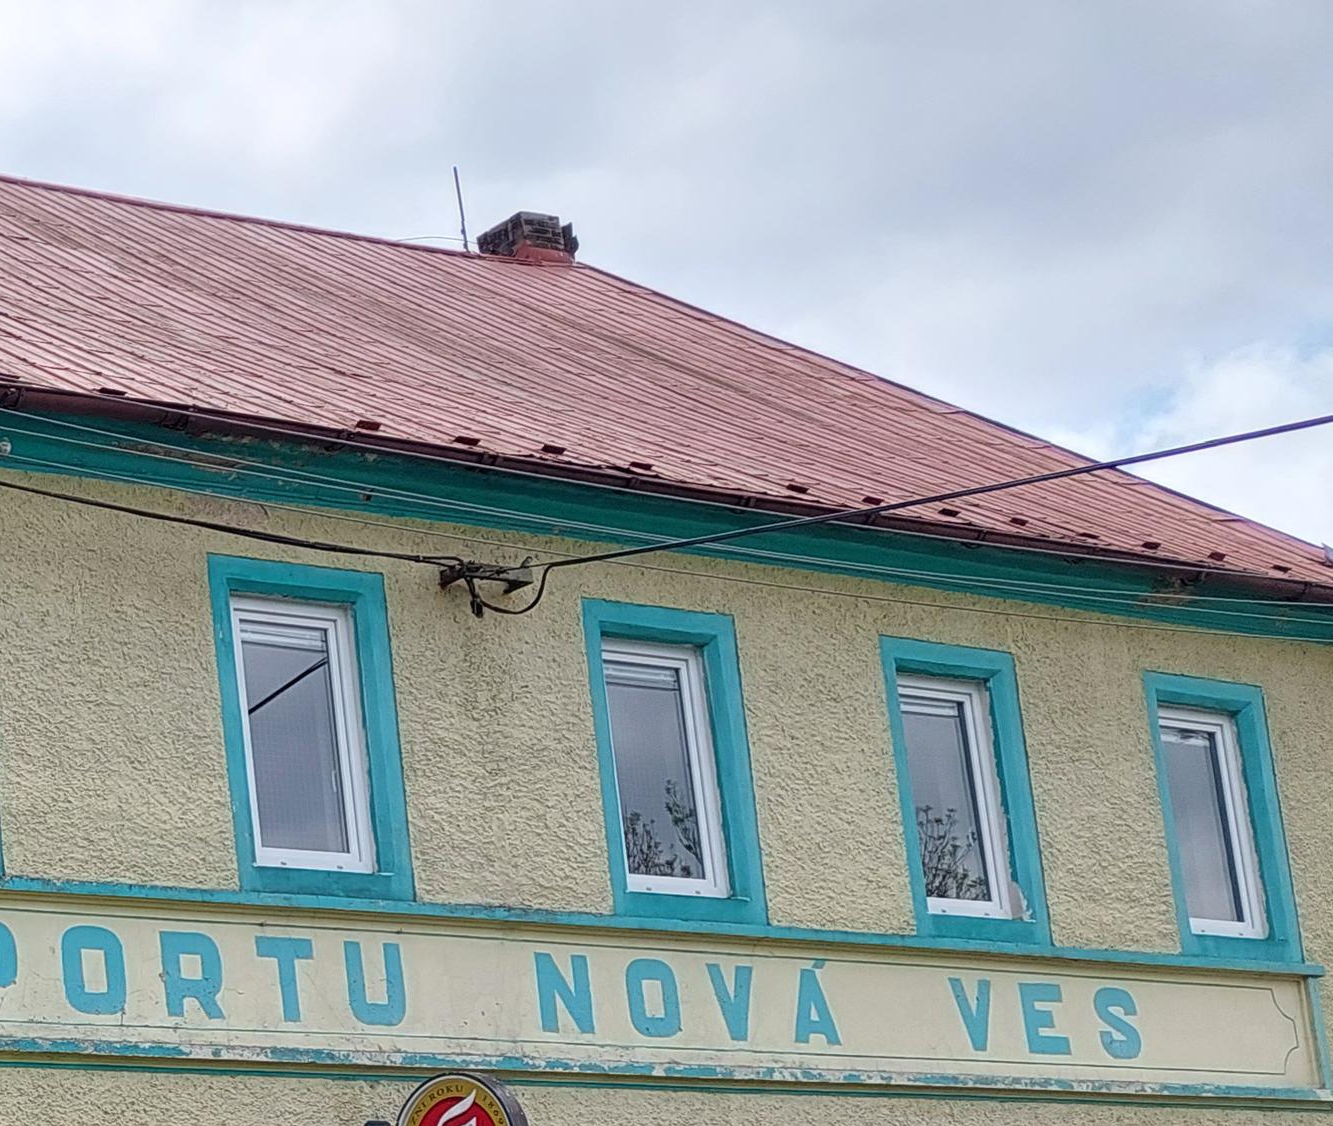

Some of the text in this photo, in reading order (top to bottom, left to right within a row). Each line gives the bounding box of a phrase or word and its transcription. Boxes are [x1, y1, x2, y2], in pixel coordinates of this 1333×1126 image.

[533, 951, 842, 1046] NOVÁ
[948, 977, 1142, 1059] VES
[428, 1084, 464, 1101] ROKU
[482, 1094, 505, 1126] 1869
